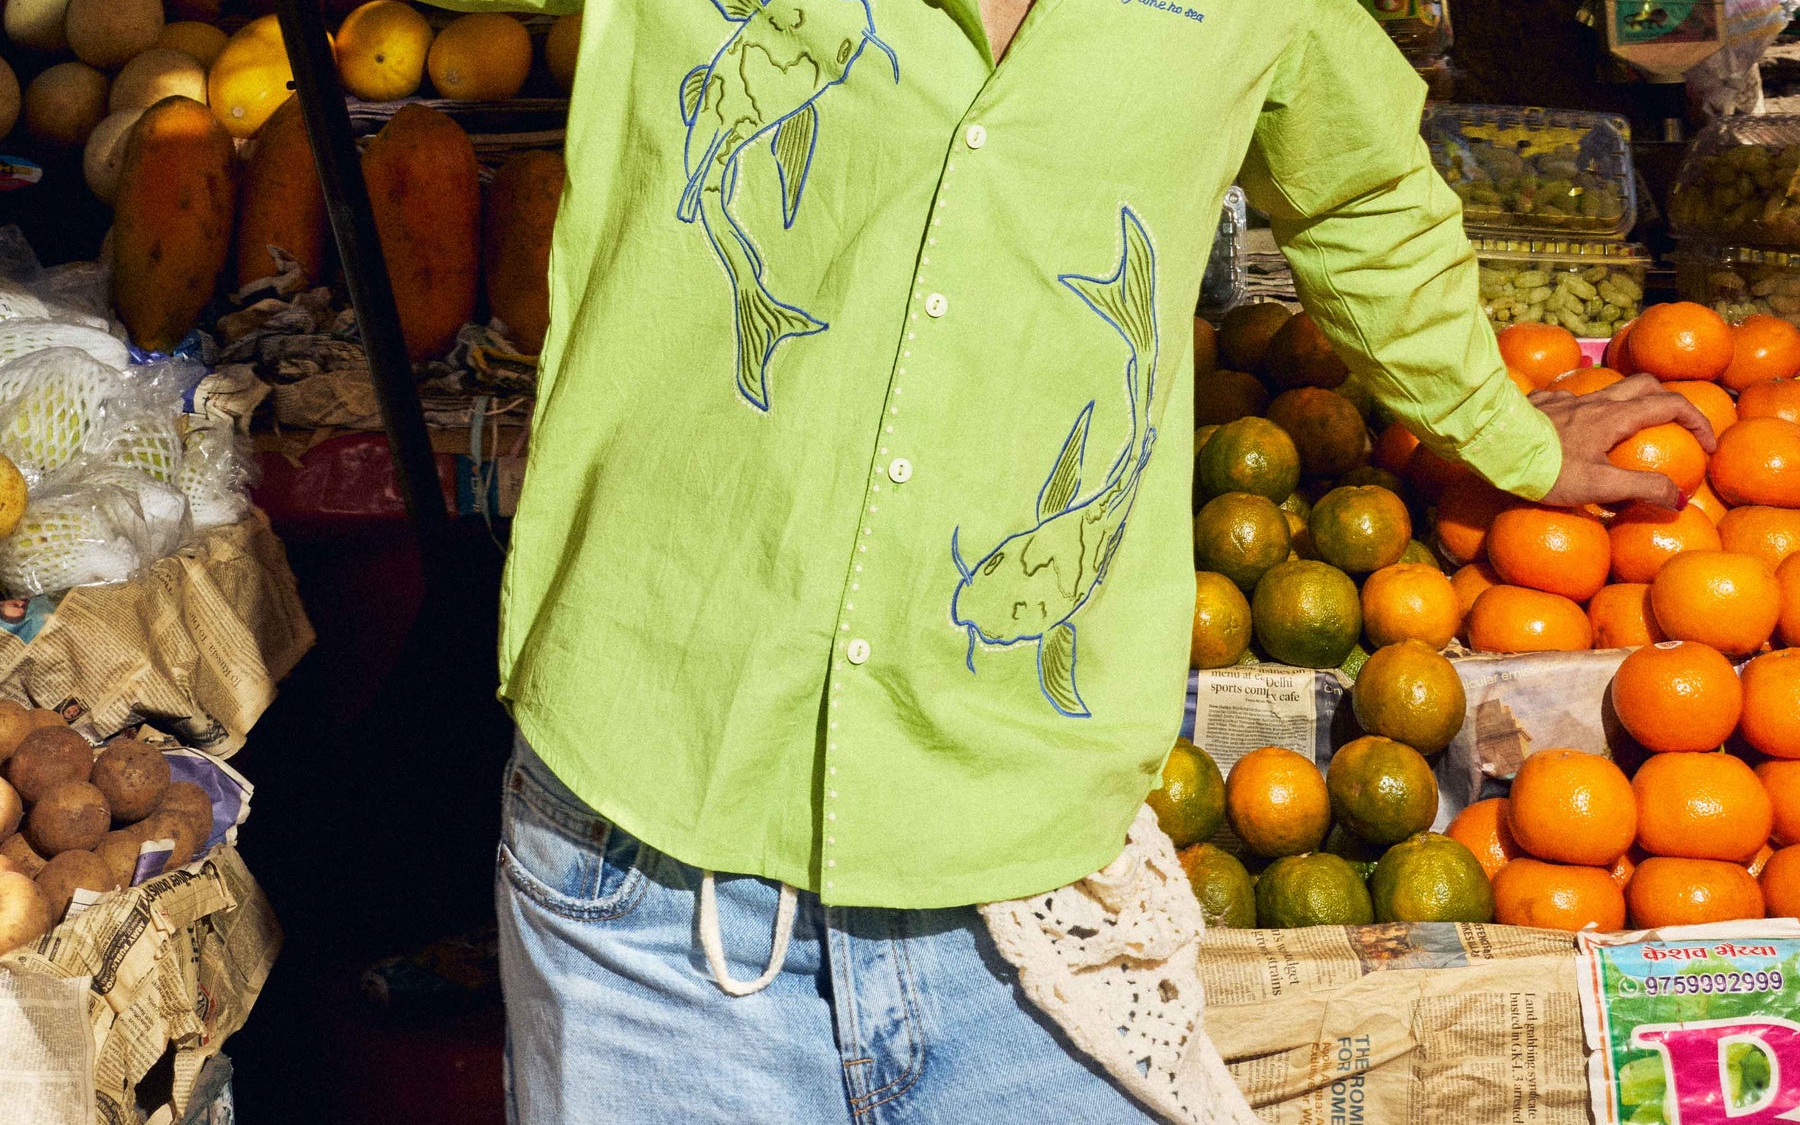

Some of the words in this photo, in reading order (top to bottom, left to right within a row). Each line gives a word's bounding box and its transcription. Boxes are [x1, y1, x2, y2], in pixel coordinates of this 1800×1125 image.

[1167, 1, 1183, 14] no
[1184, 8, 1205, 23] sea
[1210, 683, 1242, 694] sports
[1279, 691, 1300, 702] cafe
[1265, 676, 1293, 688] Delhi
[131, 921, 145, 944] ARMY
[112, 944, 130, 971] PUBLIC
[1642, 945, 1707, 961] केशव
[1644, 970, 1784, 996] 9759992999
[1509, 992, 1522, 1030] busted
[1525, 993, 1538, 1021] Land
[1512, 1032, 1522, 1041] in
[1524, 1023, 1537, 1069] grabbing
[1336, 1037, 1352, 1071] FOR
[1355, 1034, 1370, 1070] THE
[1513, 1074, 1523, 1082] 3
[1512, 1084, 1524, 1124] arrested
[1527, 1071, 1540, 1119] syndicate
